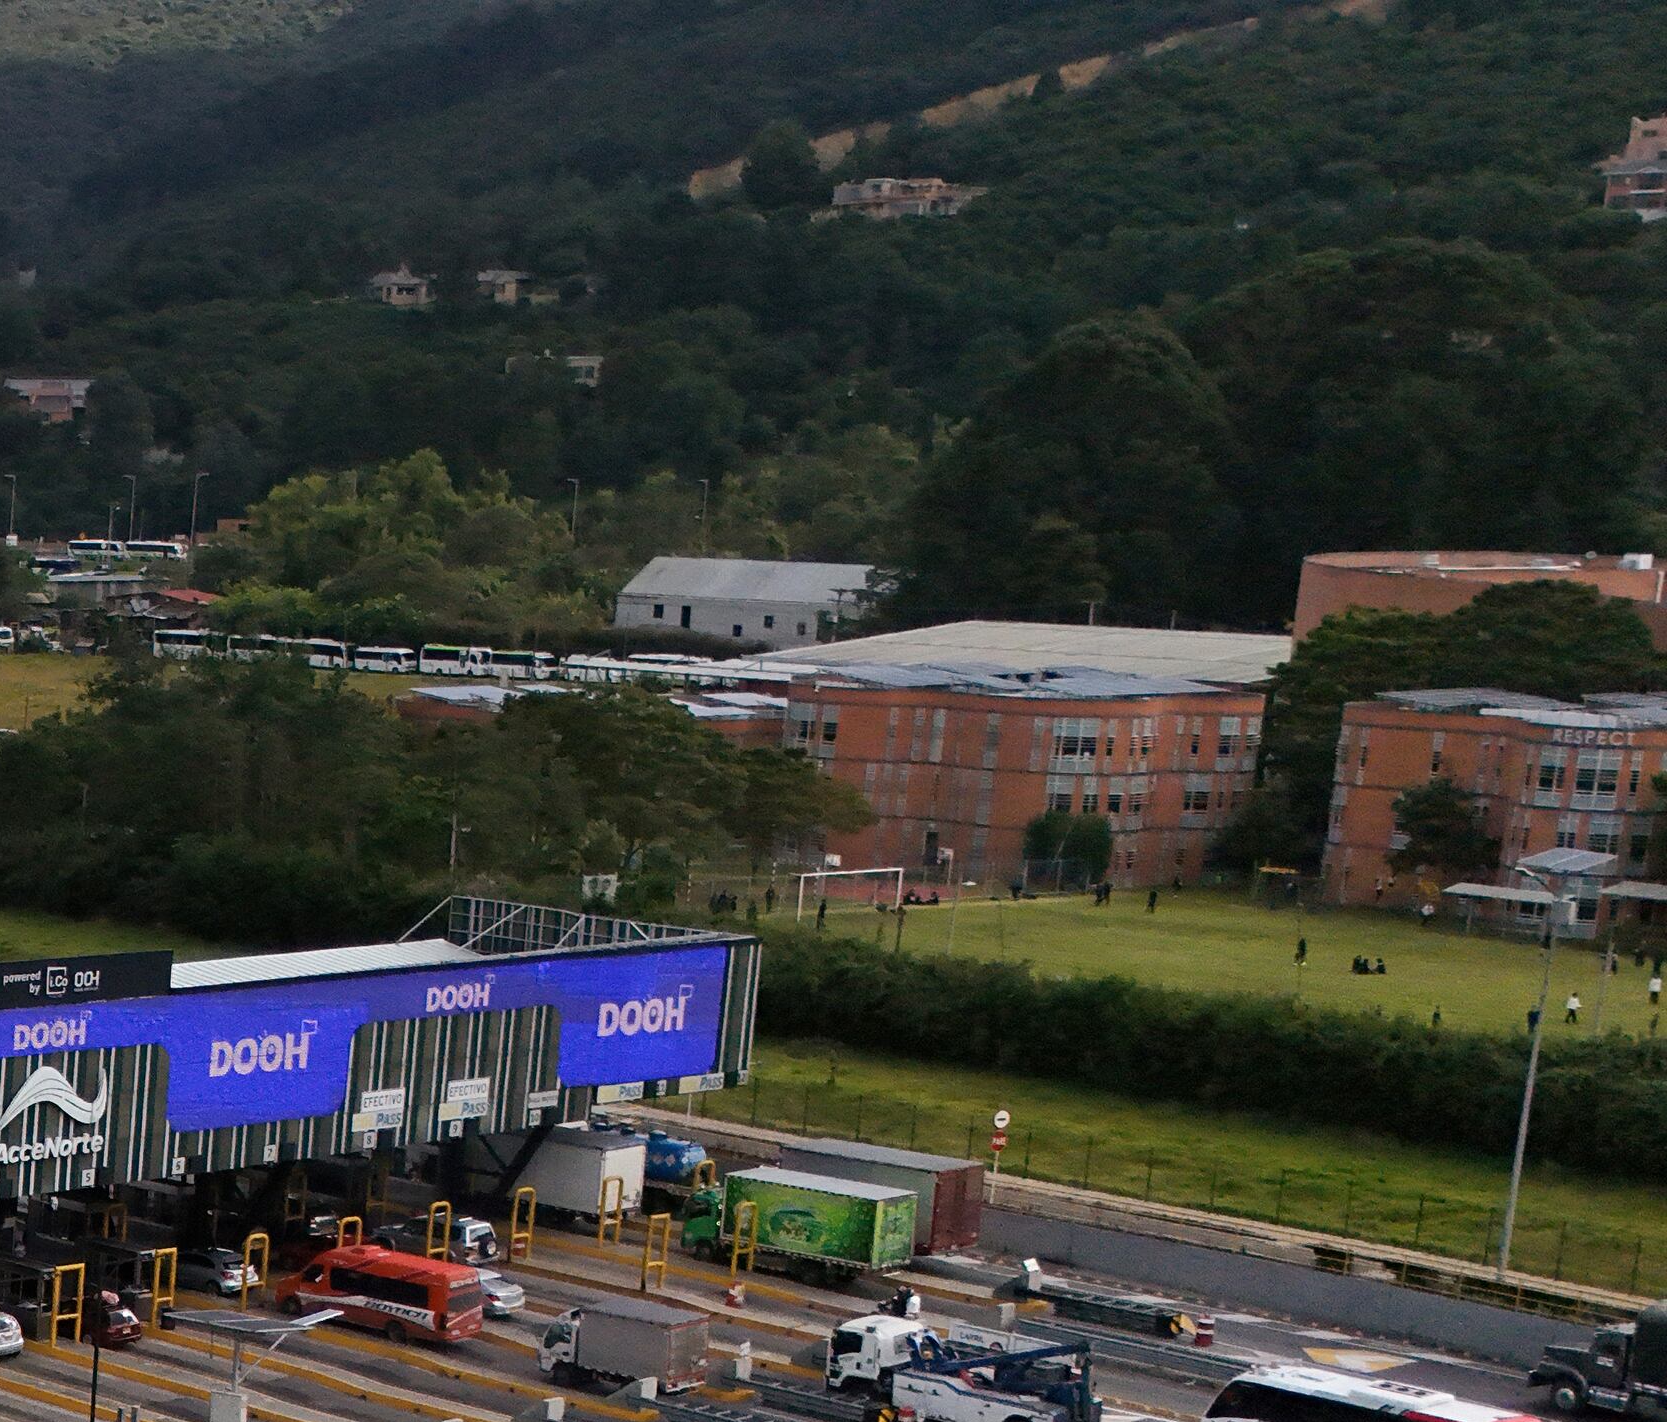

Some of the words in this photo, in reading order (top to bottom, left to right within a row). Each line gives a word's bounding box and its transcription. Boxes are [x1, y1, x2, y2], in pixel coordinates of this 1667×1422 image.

[1553, 728, 1635, 746] RESPECT
[3, 970, 41, 985] powered
[29, 984, 41, 995] by
[426, 982, 490, 1012] DOOH
[597, 997, 686, 1037] DOOH
[14, 1017, 86, 1050] DOOH
[209, 1032, 309, 1077] DOOH
[449, 1083, 486, 1098] EFECTIVO
[363, 1093, 402, 1108] EFECTIVO
[453, 1123, 458, 1133] 9
[367, 1136, 372, 1145] 8
[85, 1173, 91, 1182] 5
